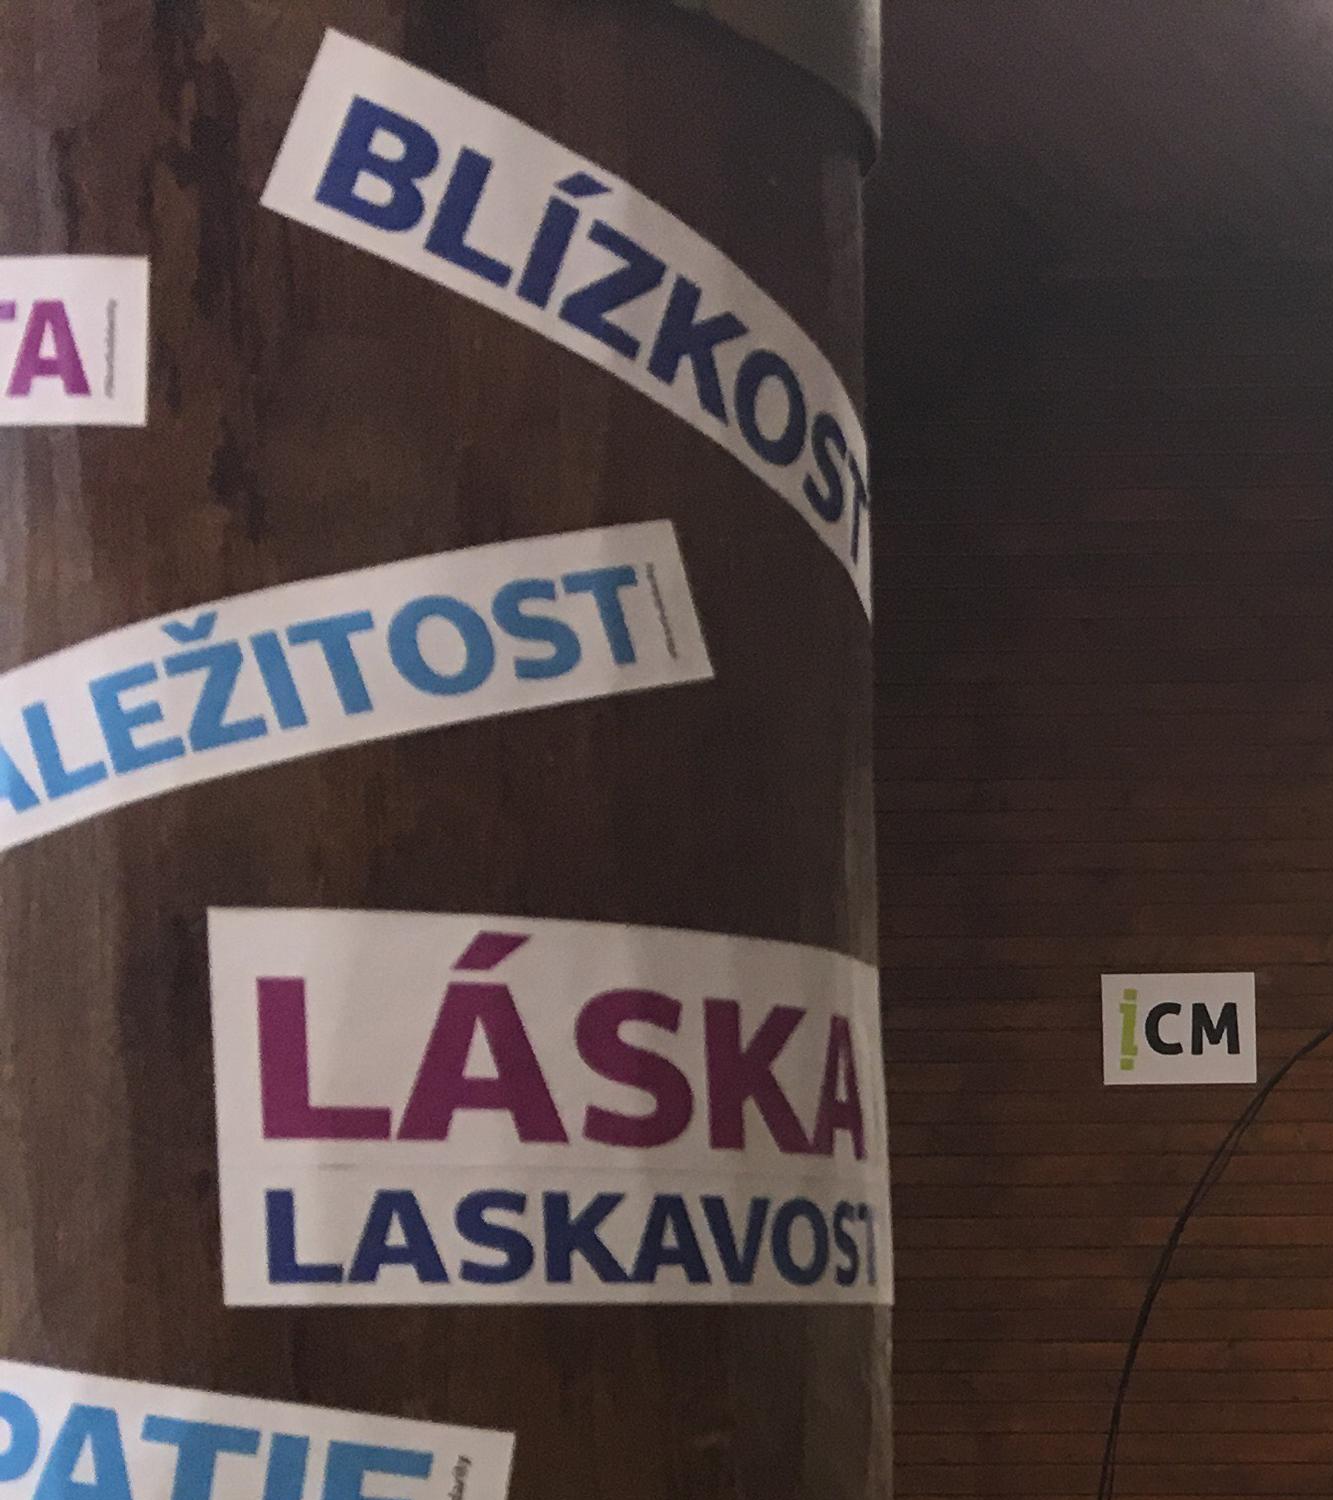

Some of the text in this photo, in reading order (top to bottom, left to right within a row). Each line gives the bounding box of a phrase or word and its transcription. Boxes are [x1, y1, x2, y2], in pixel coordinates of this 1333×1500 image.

[0, 299, 92, 398] A
[314, 95, 869, 566] BLÍZKOST
[254, 930, 867, 1160] LÁSKA
[264, 1189, 878, 1288] LASKAVOST
